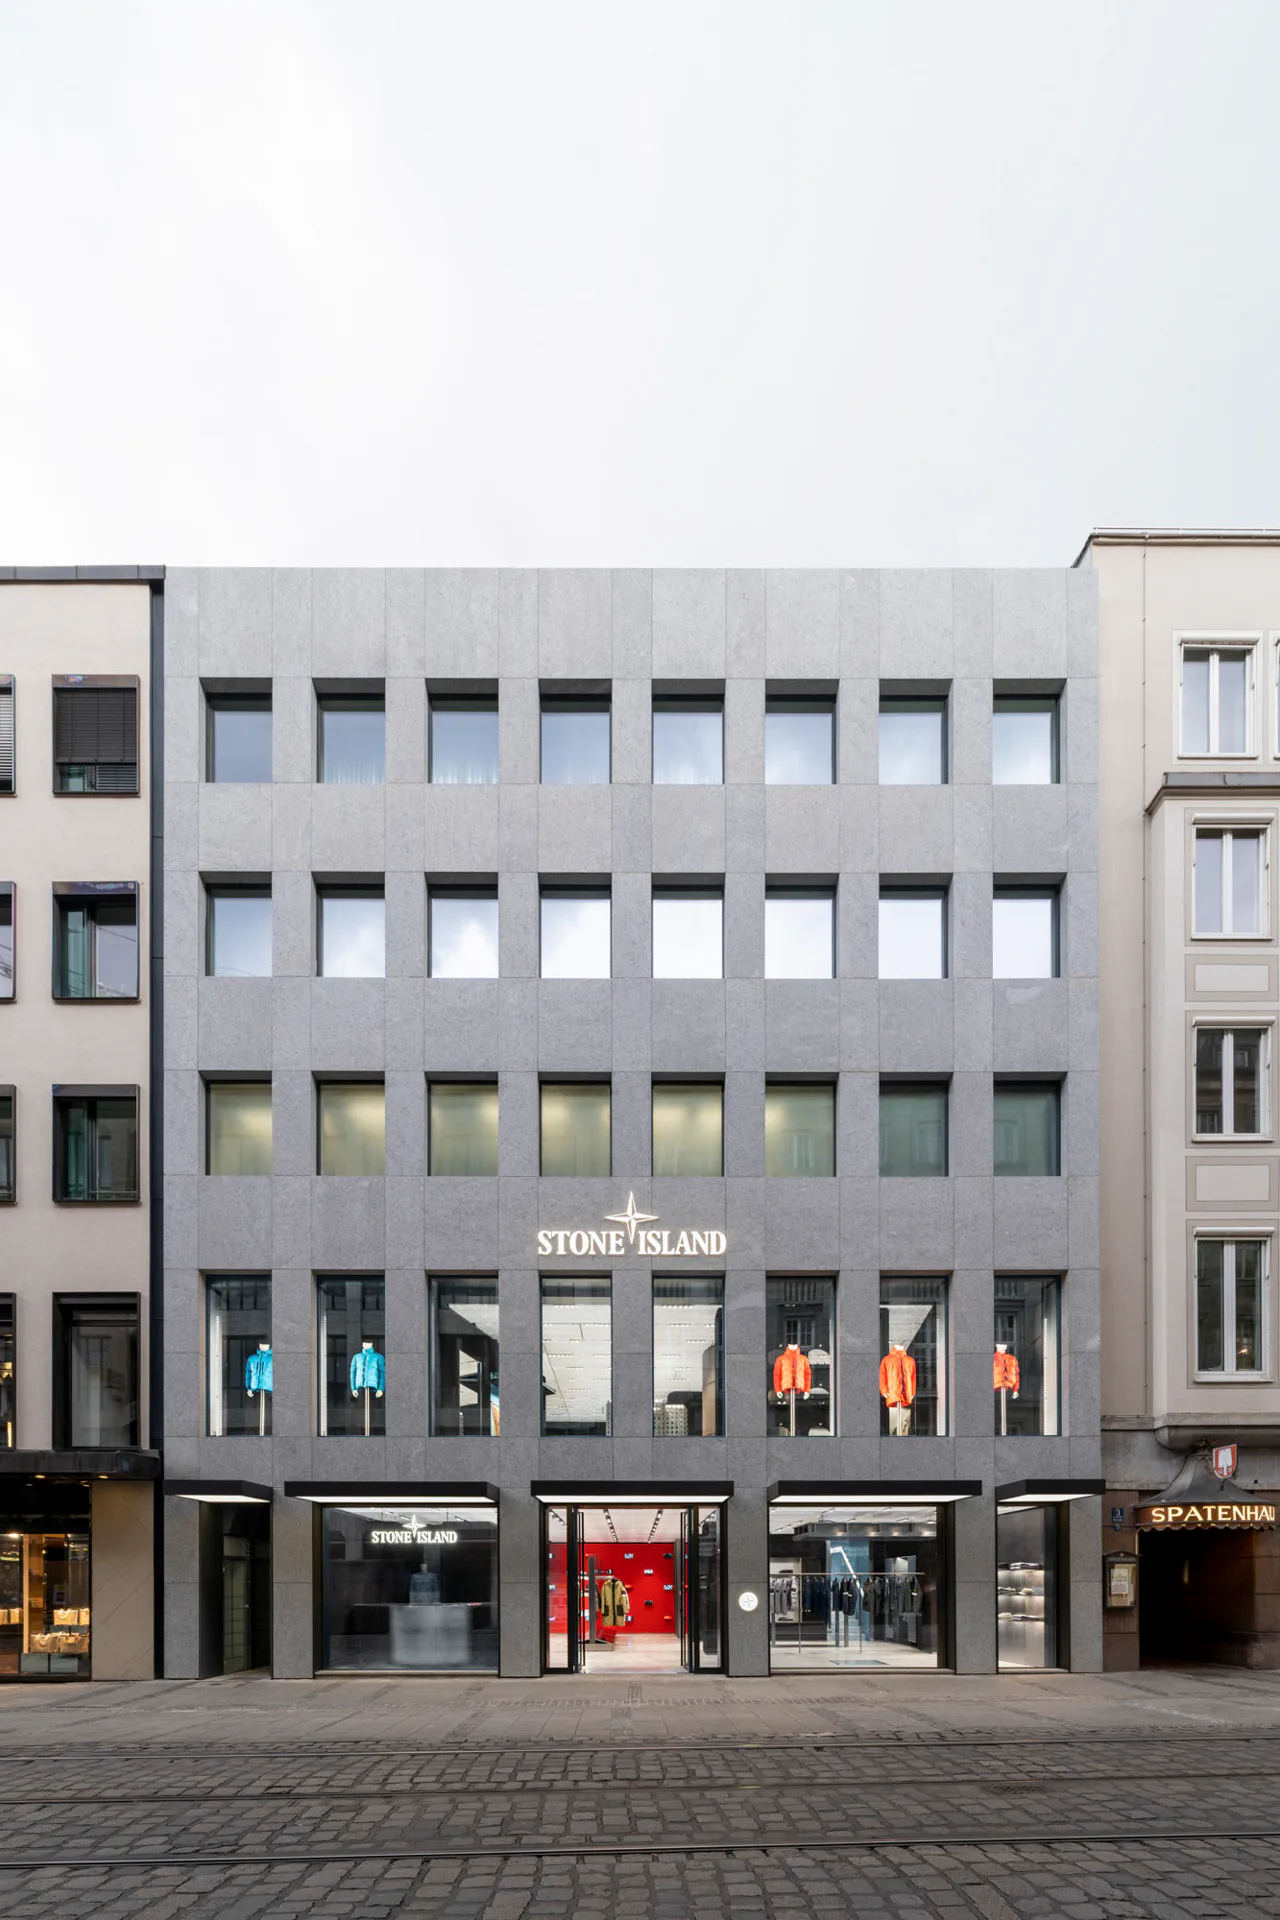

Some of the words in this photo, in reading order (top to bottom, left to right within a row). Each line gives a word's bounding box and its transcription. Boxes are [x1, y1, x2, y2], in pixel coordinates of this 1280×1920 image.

[537, 1230, 625, 1256] STONE
[637, 1230, 727, 1256] ISLAND
[371, 1530, 412, 1543] STONE
[416, 1530, 458, 1543] ISLAND
